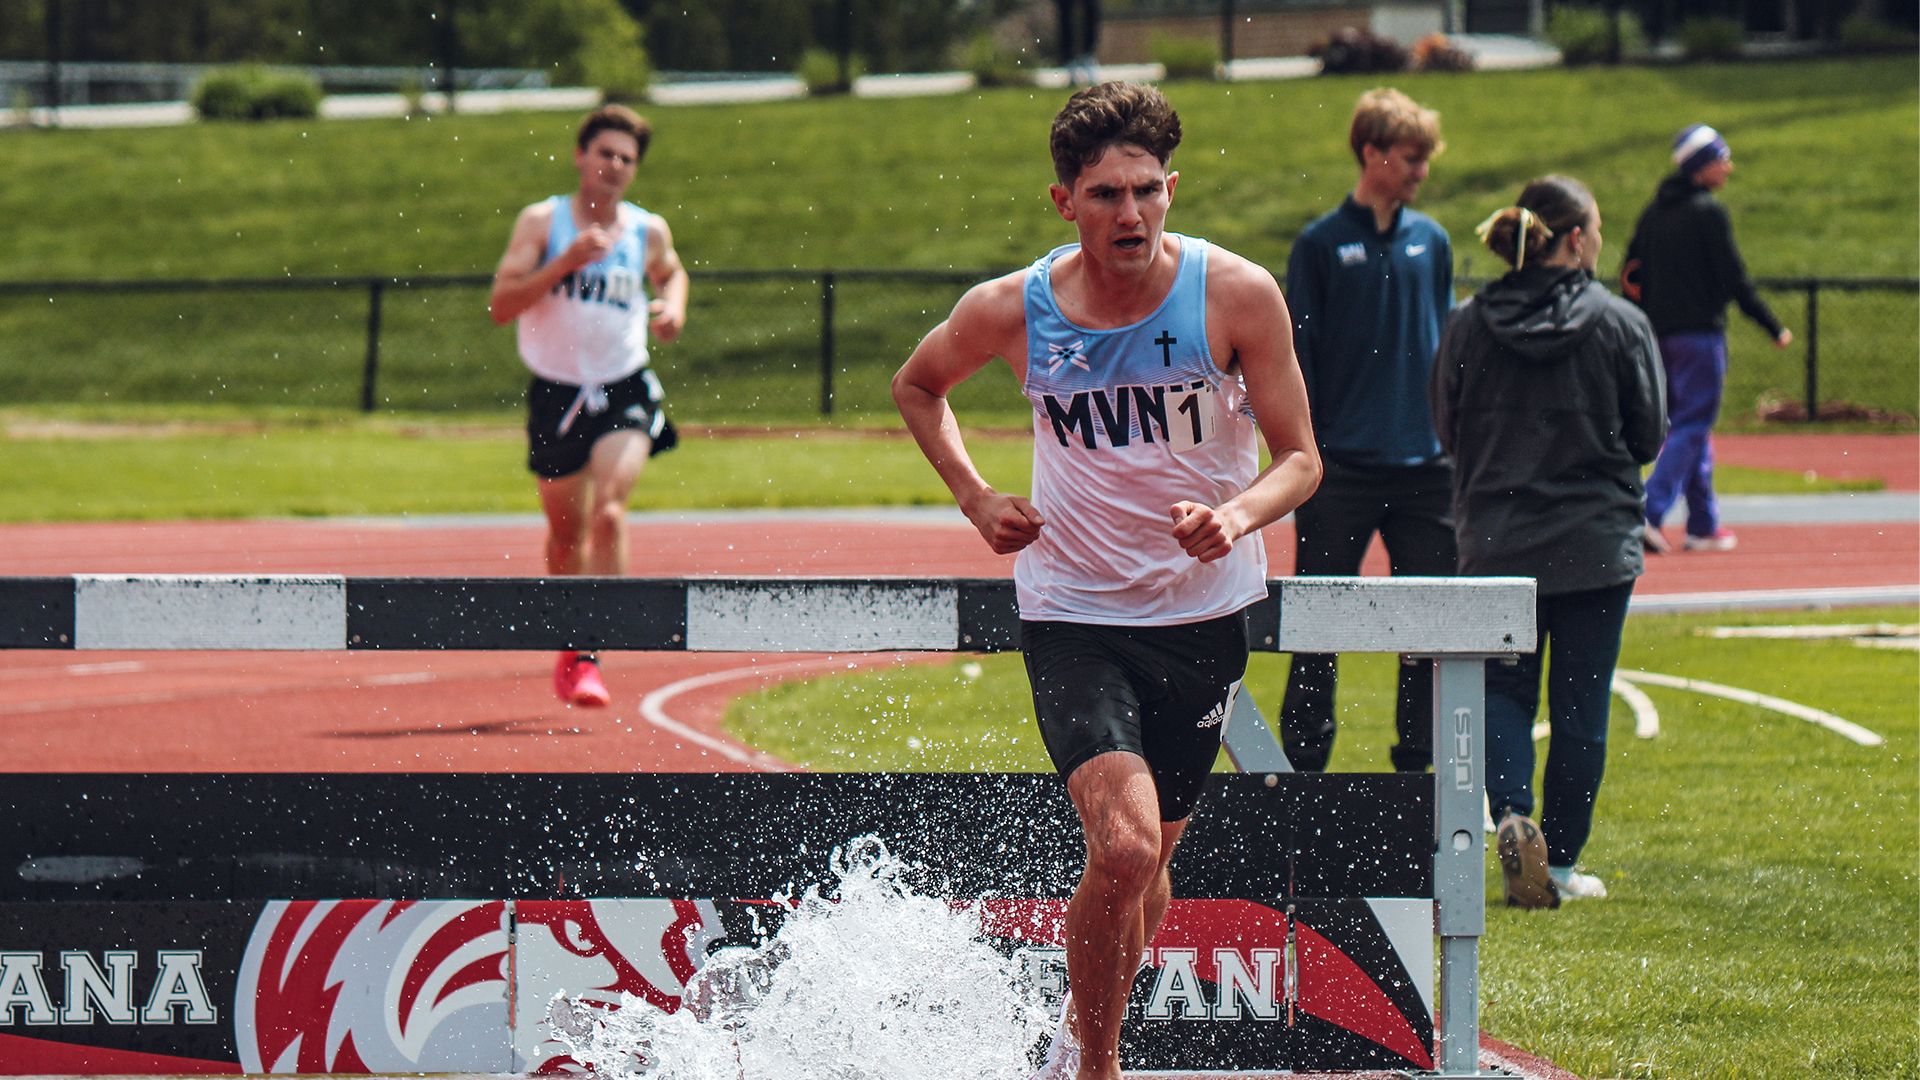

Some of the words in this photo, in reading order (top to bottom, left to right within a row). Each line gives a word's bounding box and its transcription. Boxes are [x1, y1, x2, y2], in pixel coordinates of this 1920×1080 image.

[1042, 380, 1205, 449] MVN
[1178, 394, 1202, 445] 1
[1197, 715, 1223, 728] adida
[1454, 708, 1473, 790] UCS
[0, 950, 217, 1025] ANA
